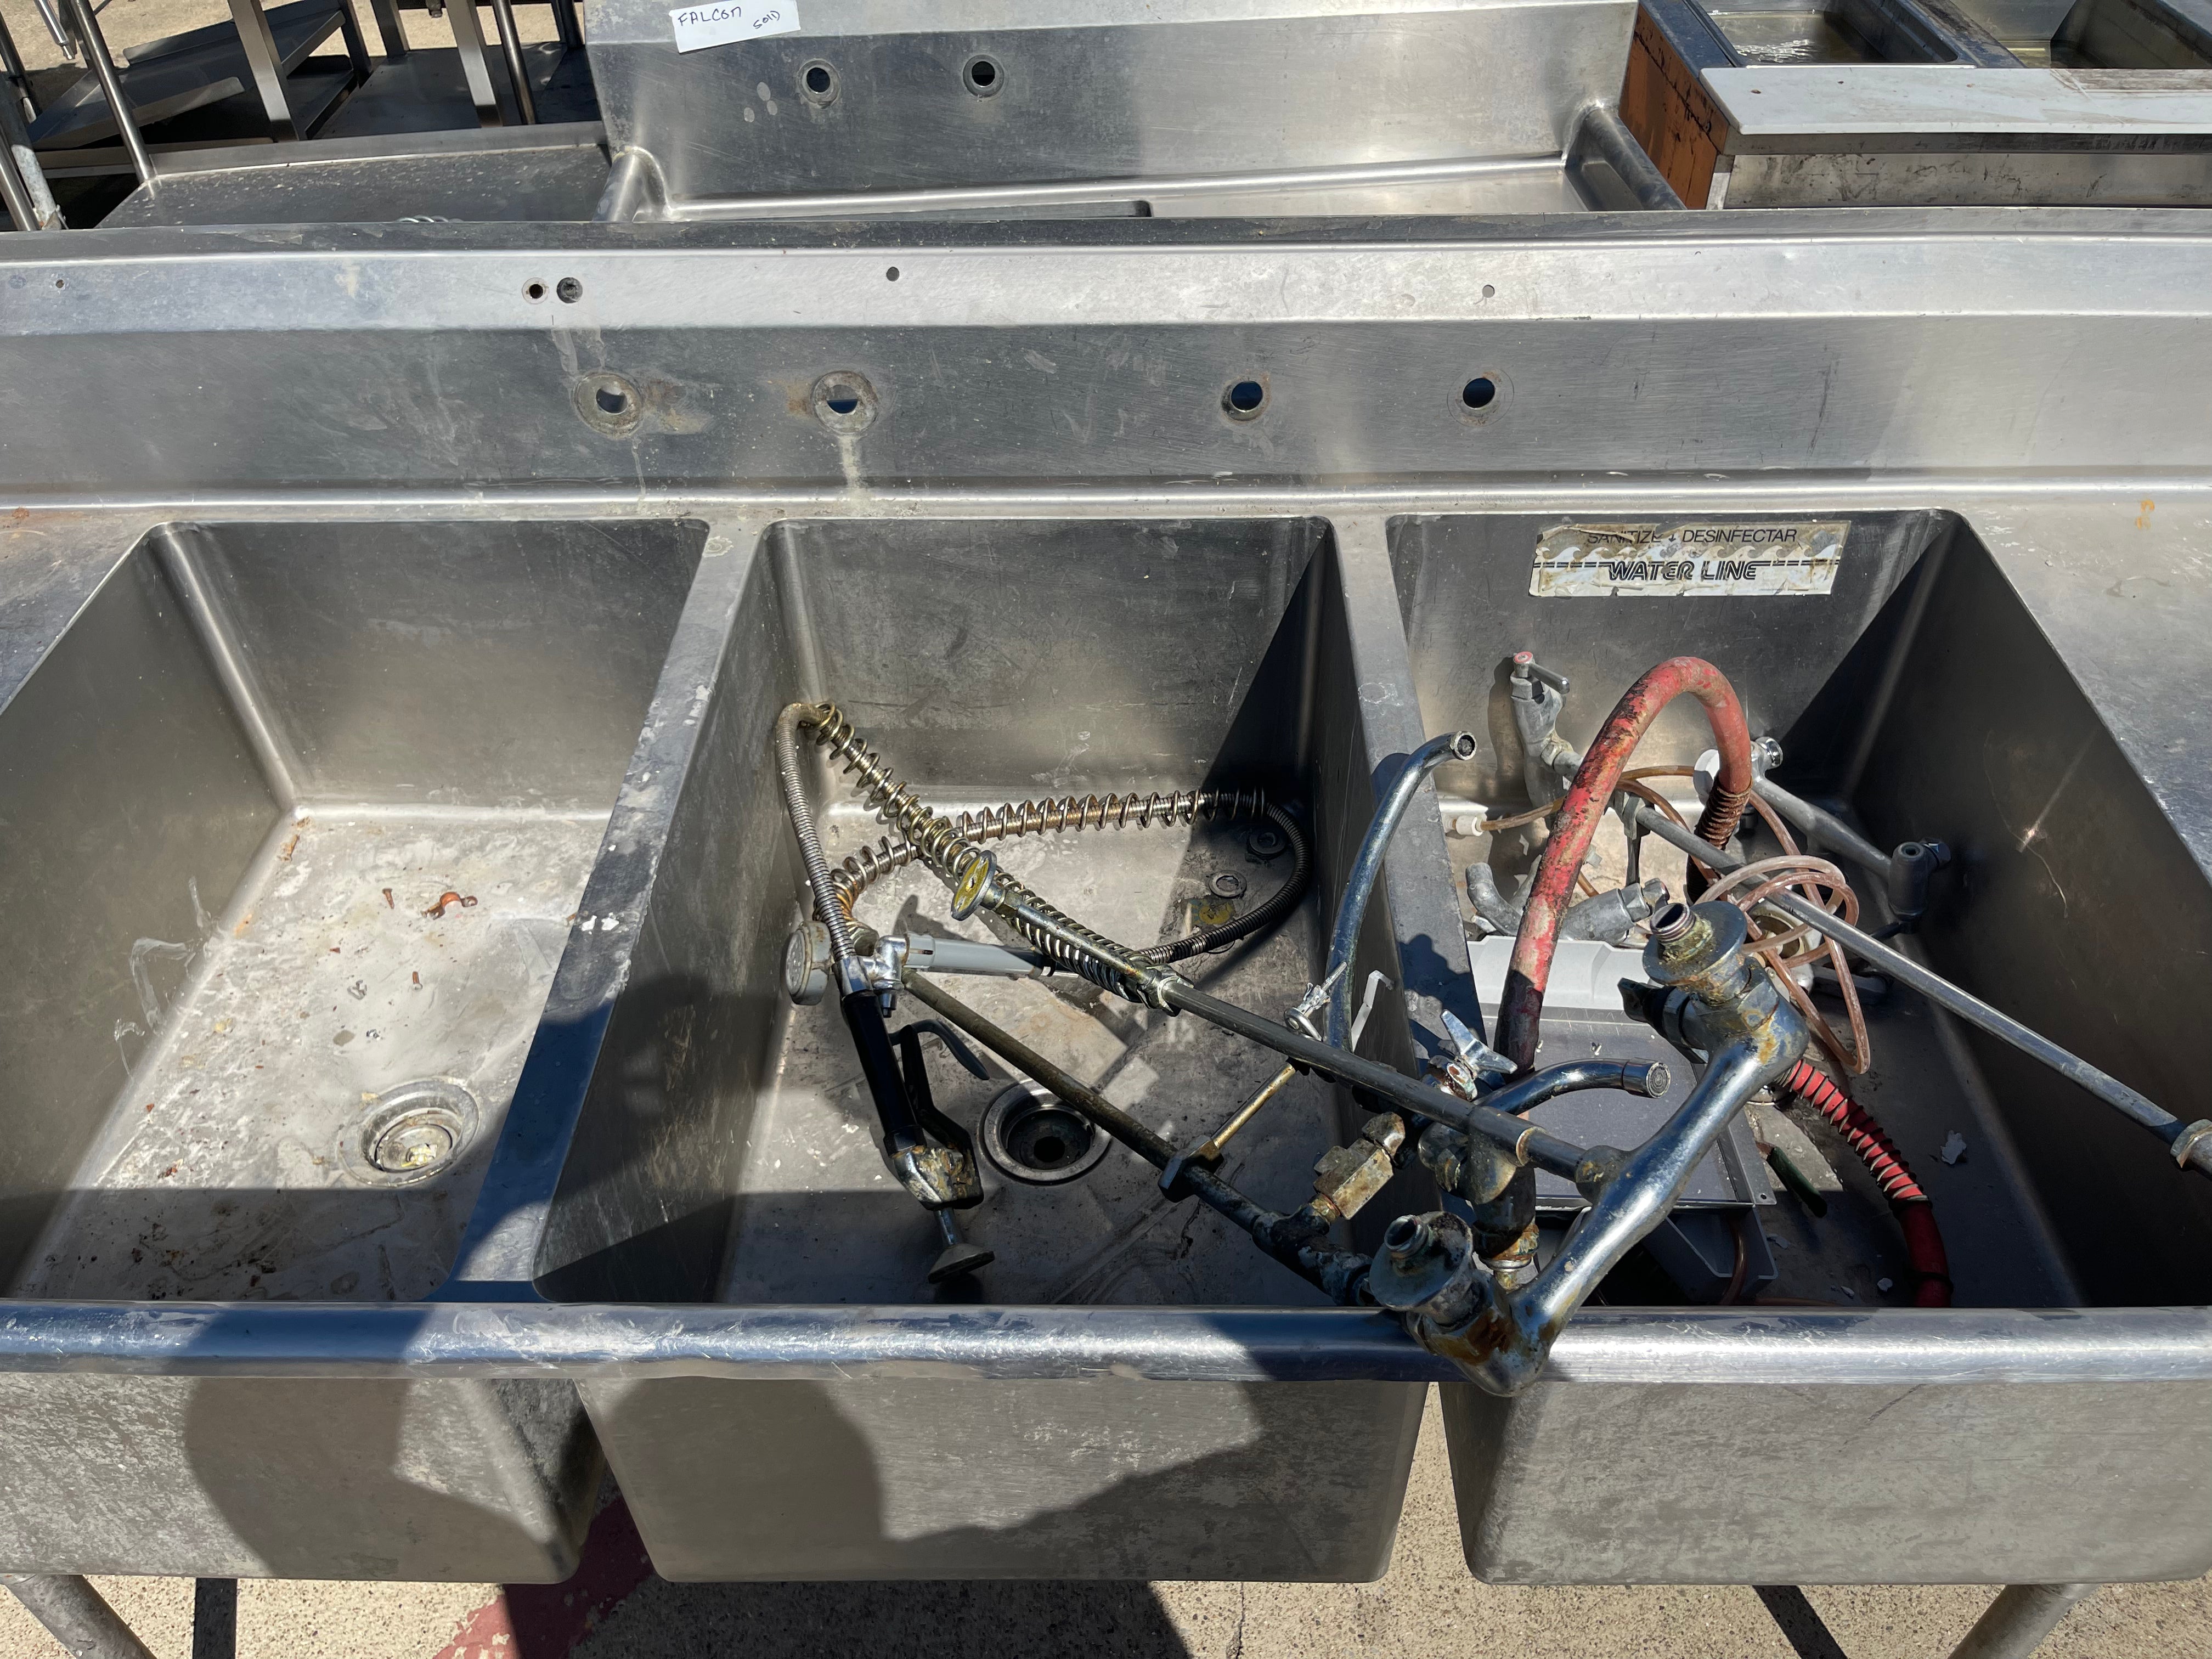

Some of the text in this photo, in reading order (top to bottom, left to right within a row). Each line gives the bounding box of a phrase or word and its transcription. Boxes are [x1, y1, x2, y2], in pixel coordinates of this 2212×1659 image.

[1683, 529, 1797, 542] DESINFECTAR
[1609, 561, 1757, 580] WATER LINE
